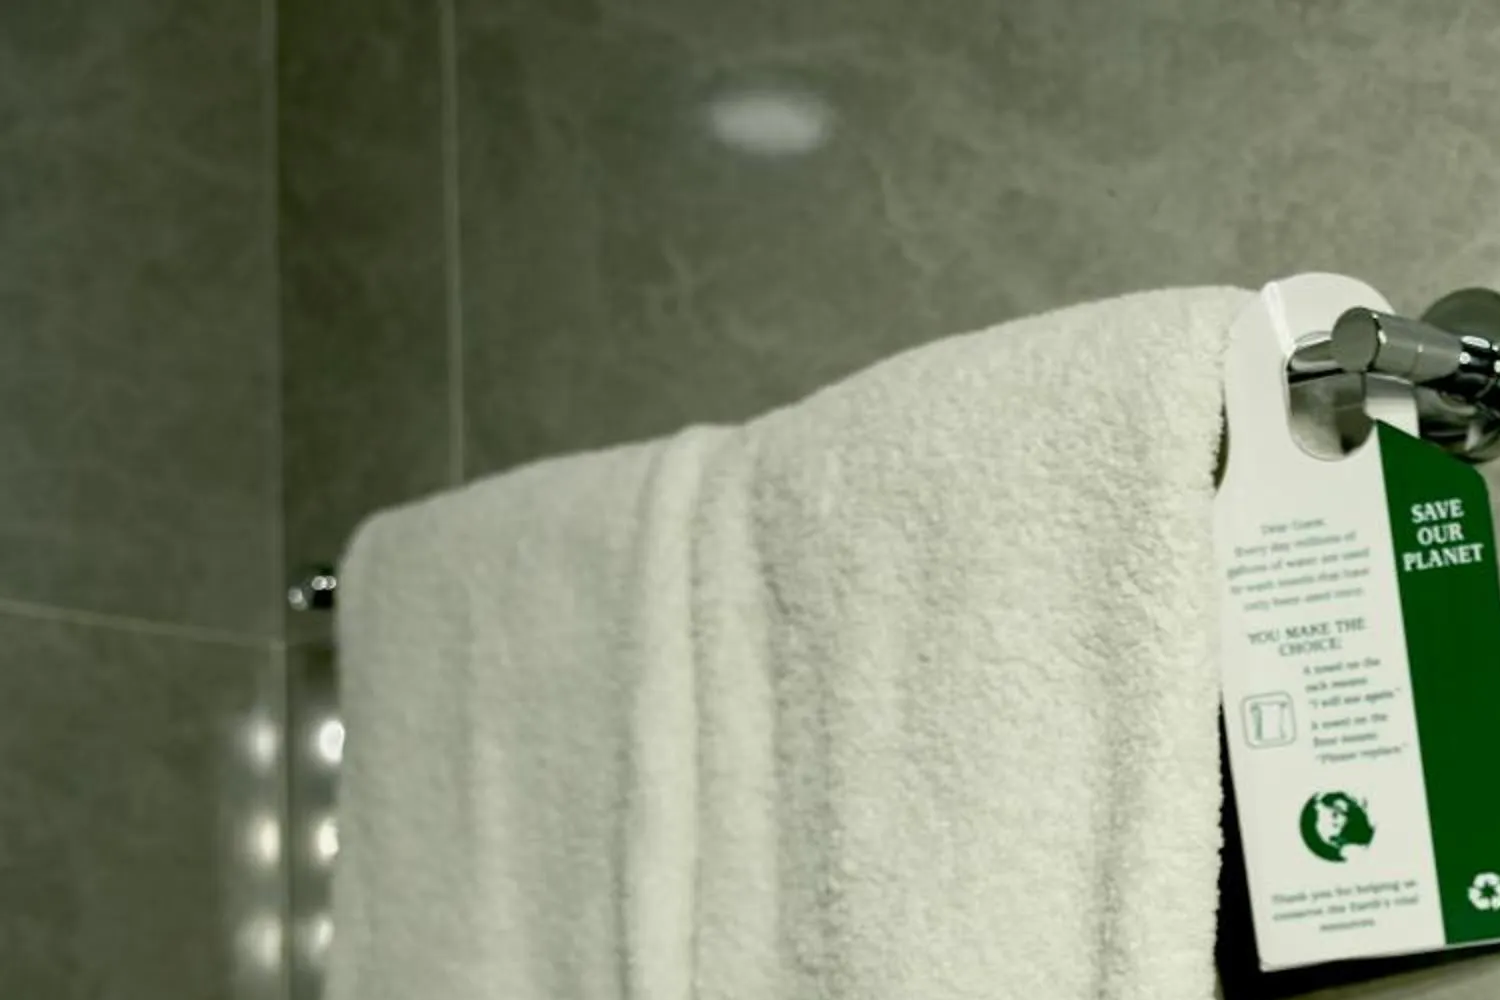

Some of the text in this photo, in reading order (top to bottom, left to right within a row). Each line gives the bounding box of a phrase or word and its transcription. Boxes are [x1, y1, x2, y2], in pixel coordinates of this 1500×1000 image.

[1410, 497, 1465, 523] SAVE
[1416, 522, 1465, 546] OUR
[1402, 542, 1484, 572] PLANET
[1248, 616, 1366, 645] YOU MAKE THE
